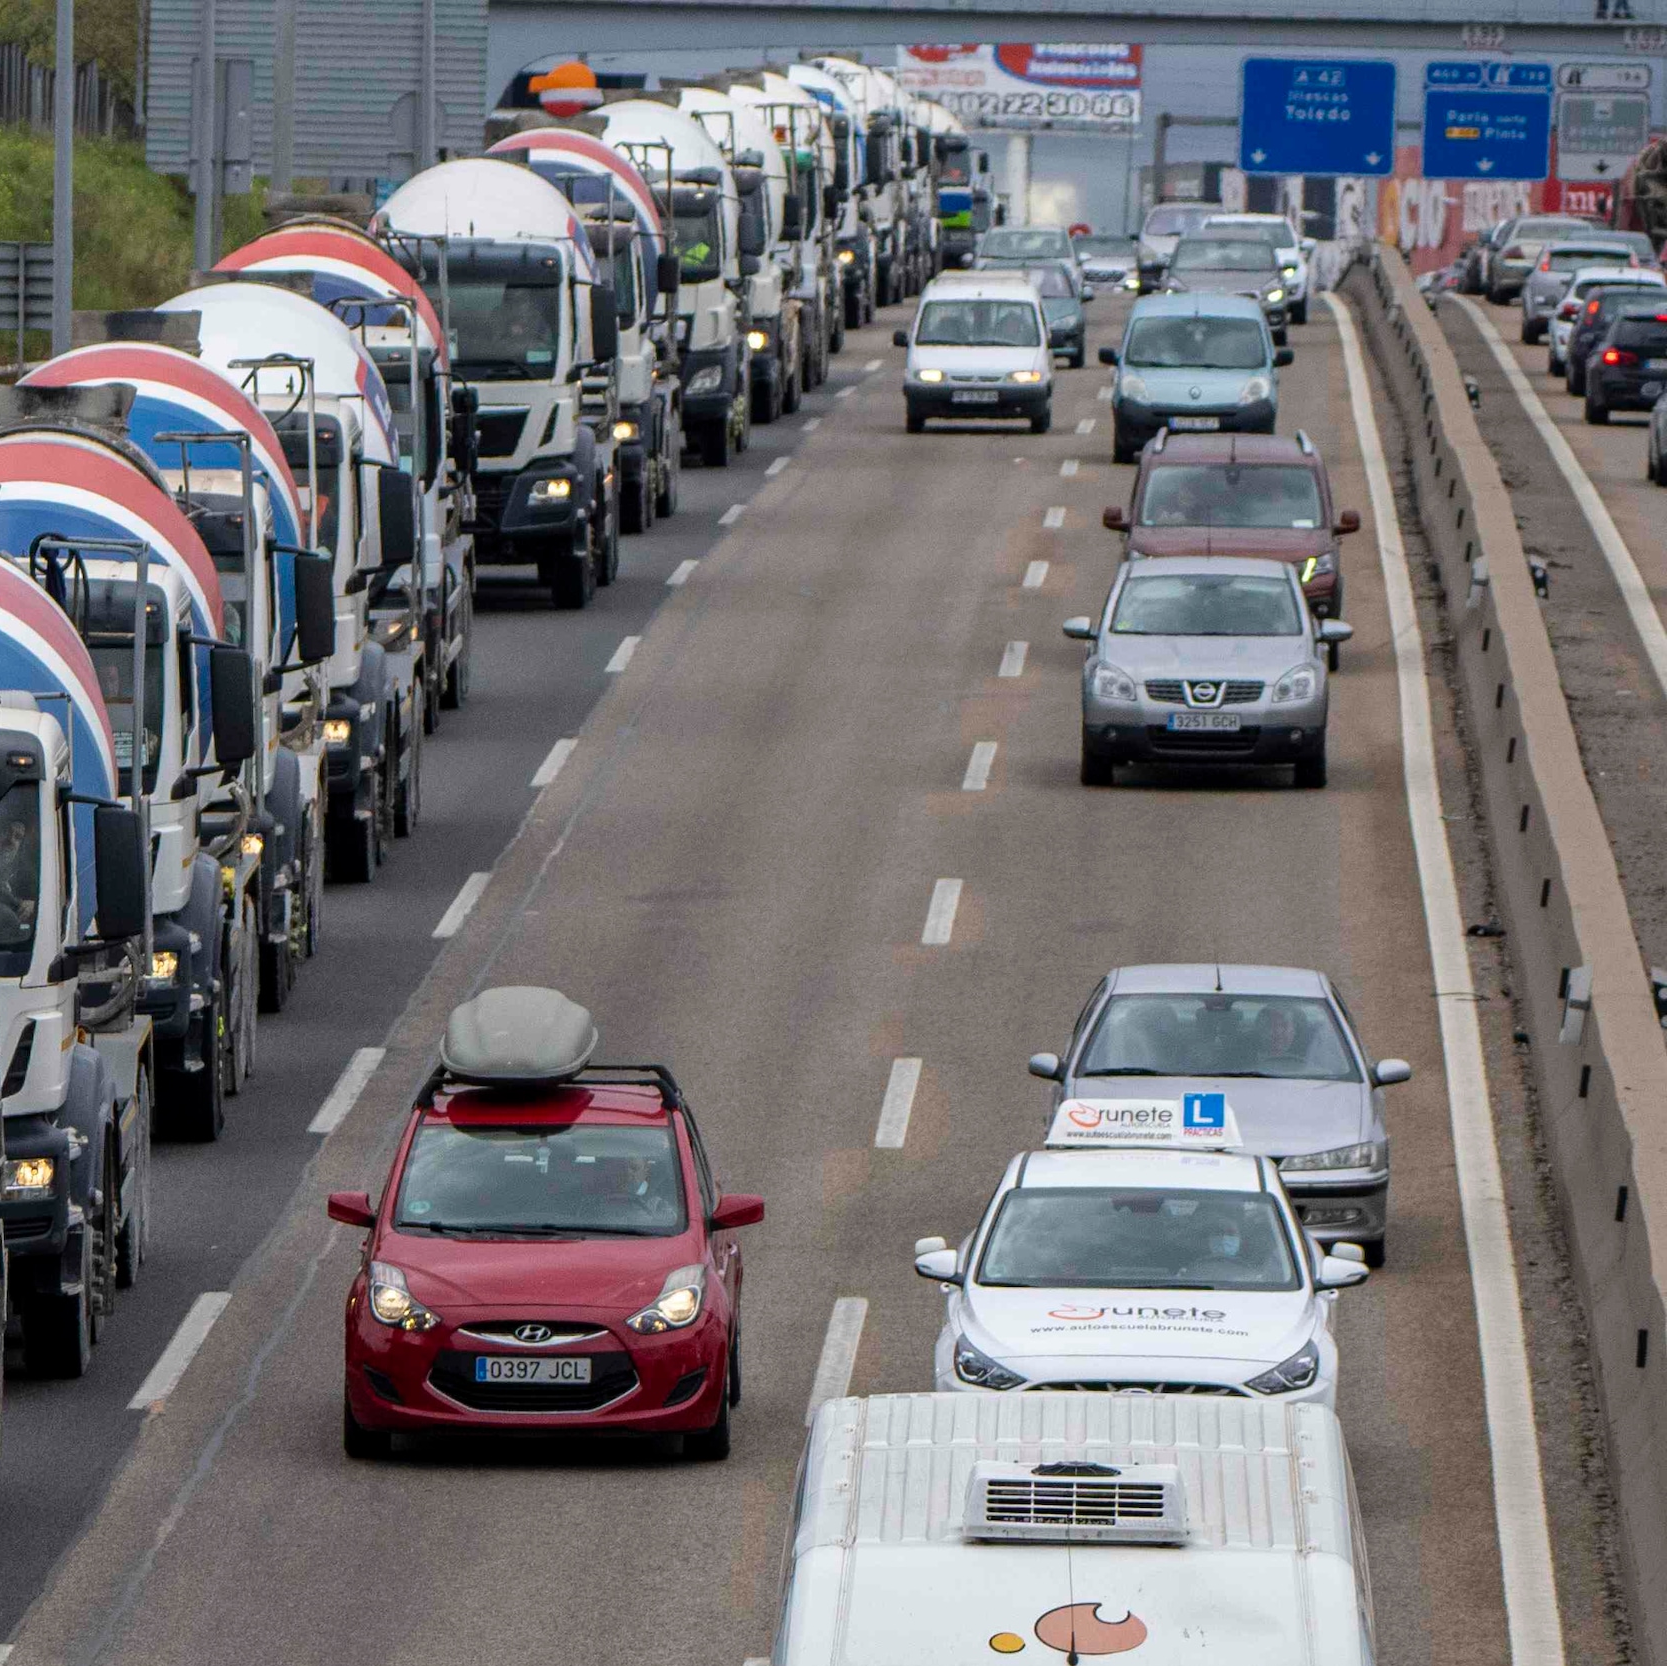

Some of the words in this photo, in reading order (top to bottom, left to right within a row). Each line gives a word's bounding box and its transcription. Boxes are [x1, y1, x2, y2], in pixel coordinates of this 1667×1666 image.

[1285, 104, 1351, 121] Toledo
[1193, 1100, 1214, 1123] L
[1030, 1323, 1249, 1337] www.autoescuelabrunete.com
[490, 1361, 540, 1379] 0397
[549, 1361, 586, 1380] JCL
